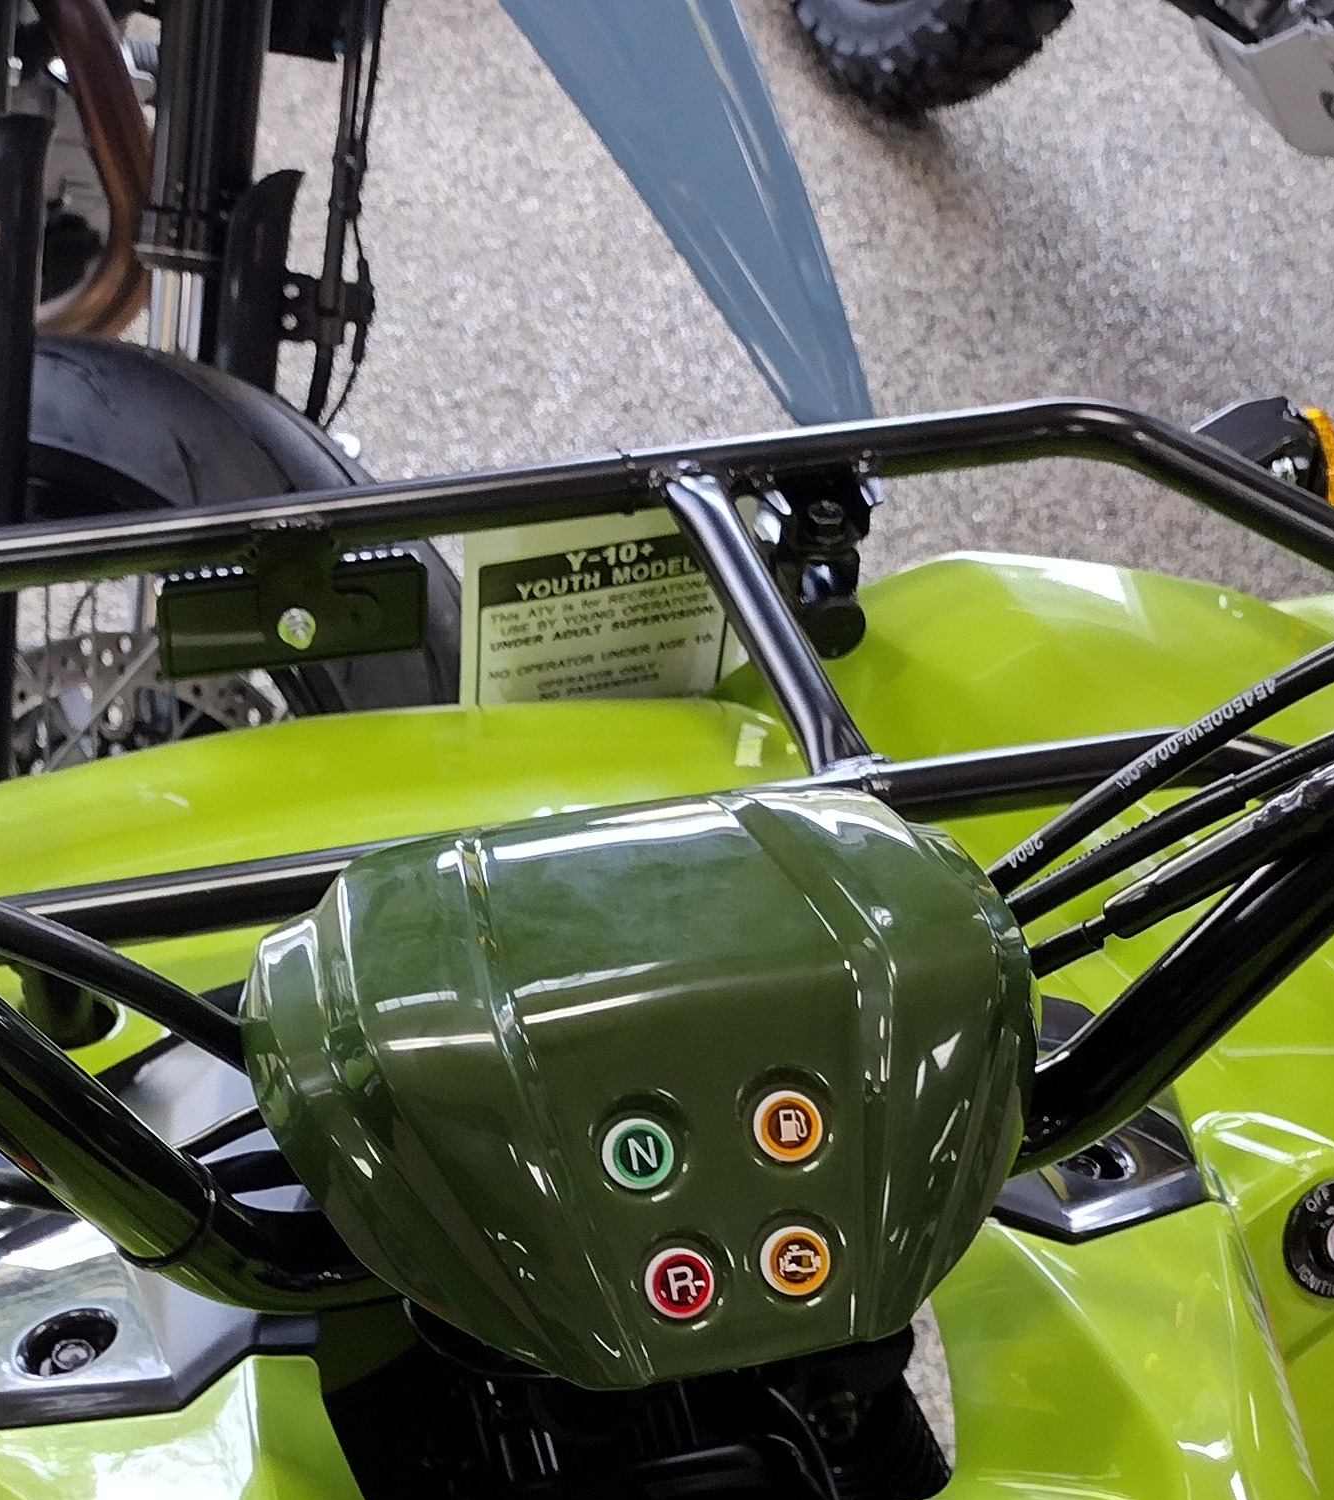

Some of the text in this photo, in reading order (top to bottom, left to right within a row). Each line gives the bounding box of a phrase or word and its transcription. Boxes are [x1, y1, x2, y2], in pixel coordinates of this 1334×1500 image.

[565, 541, 654, 571] Y-10+
[516, 571, 600, 600] YOUTH
[627, 1135, 659, 1173] N
[1305, 1185, 1331, 1213] OFF
[666, 1265, 698, 1302] R
